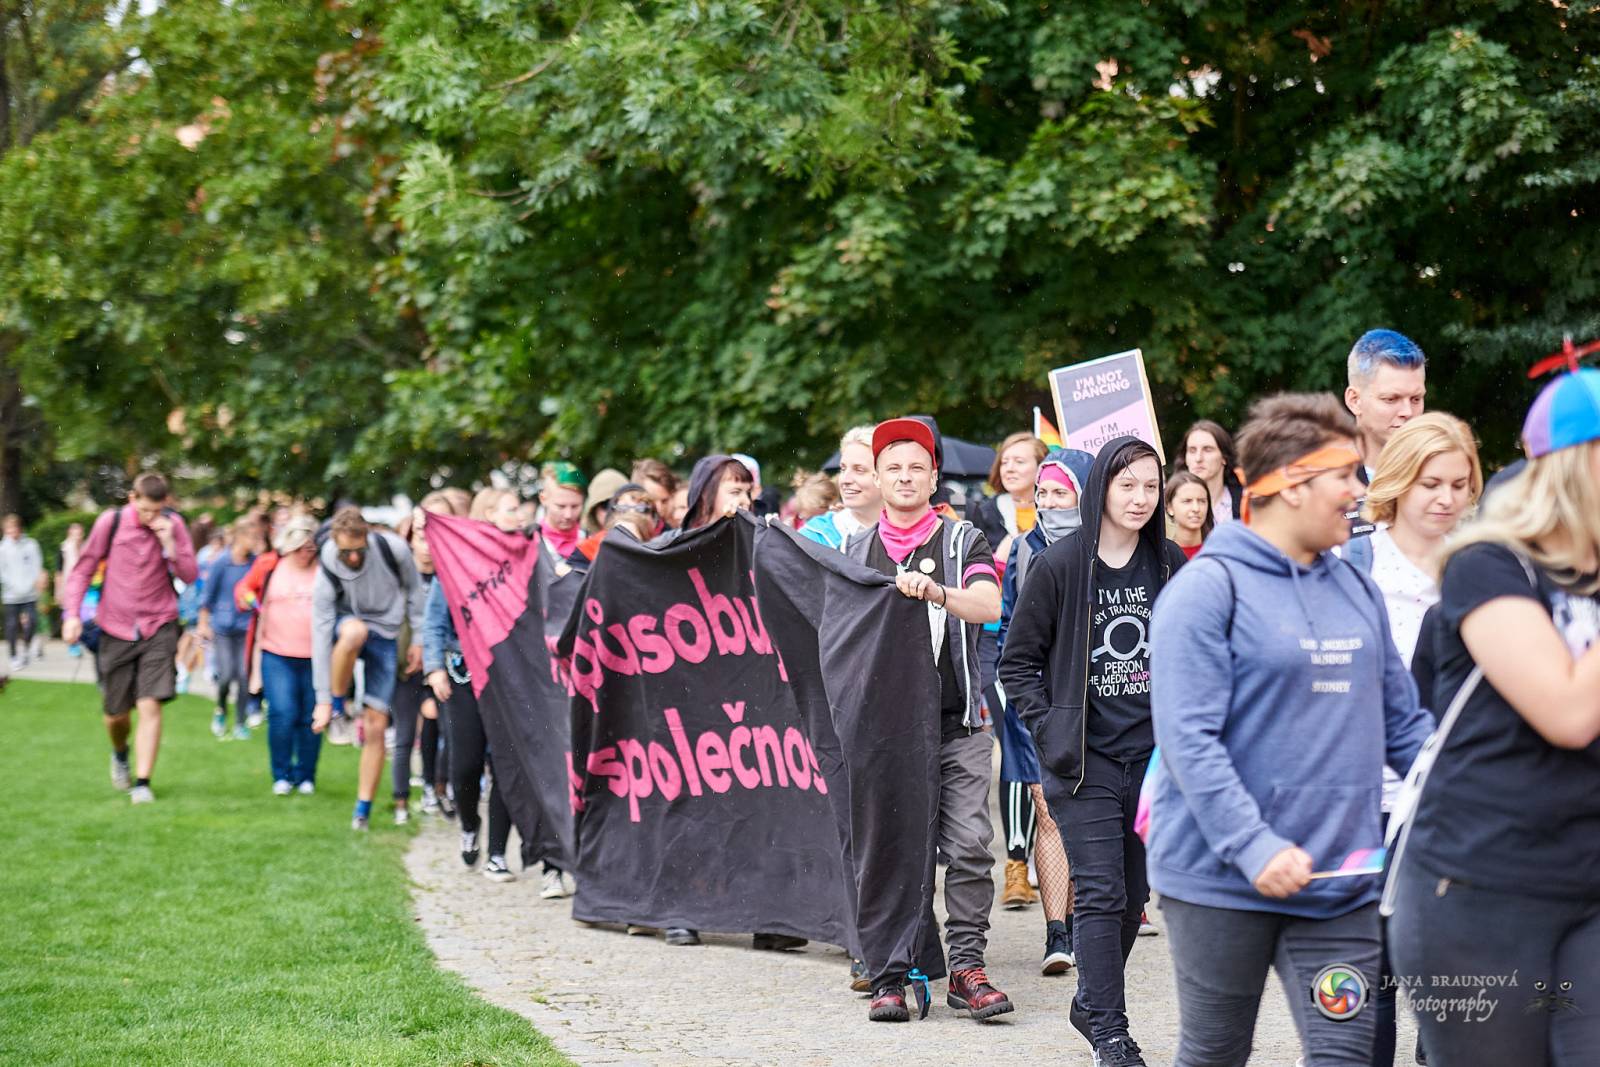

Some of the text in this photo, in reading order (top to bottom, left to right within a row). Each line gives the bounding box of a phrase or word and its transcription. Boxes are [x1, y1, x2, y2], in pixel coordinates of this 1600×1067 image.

[1075, 369, 1123, 391] I'M NOT
[1072, 378, 1130, 402] DANCING
[1100, 422, 1118, 434] I'M
[1098, 586, 1148, 605] I'M THE
[1107, 603, 1152, 621] TRANSGEN
[1104, 660, 1144, 675] PERSON
[1101, 674, 1129, 685] MEDIA
[1129, 671, 1150, 683] WAR
[1096, 680, 1151, 697] YOU ABOU
